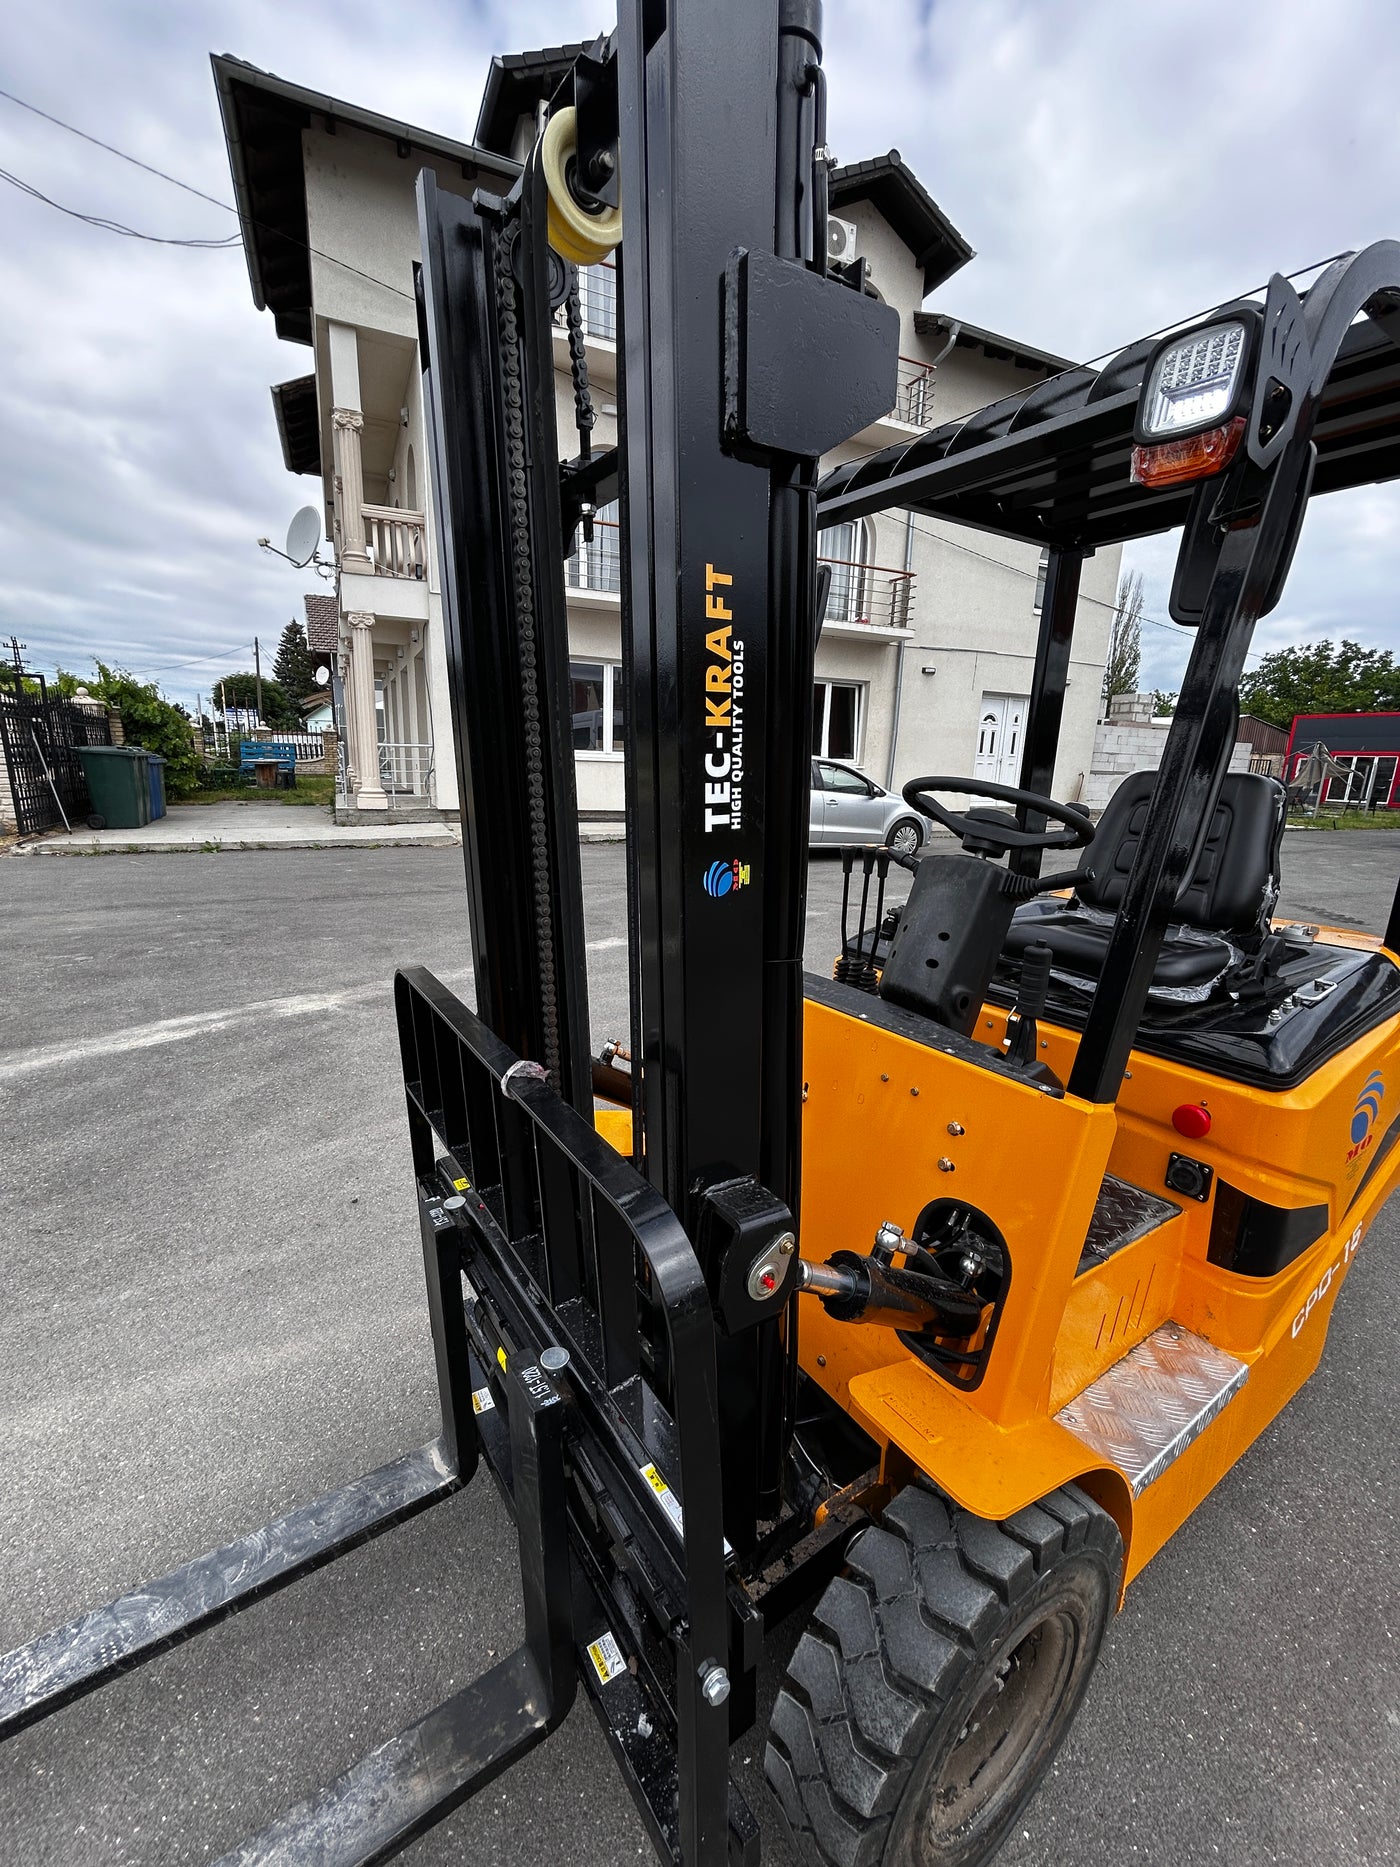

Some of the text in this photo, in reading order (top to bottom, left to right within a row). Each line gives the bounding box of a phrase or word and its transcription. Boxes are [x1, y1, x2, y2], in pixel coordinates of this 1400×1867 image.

[705, 563, 732, 833] TEC-KRAFT
[731, 640, 745, 830] HIGH QUALITY TOOLS
